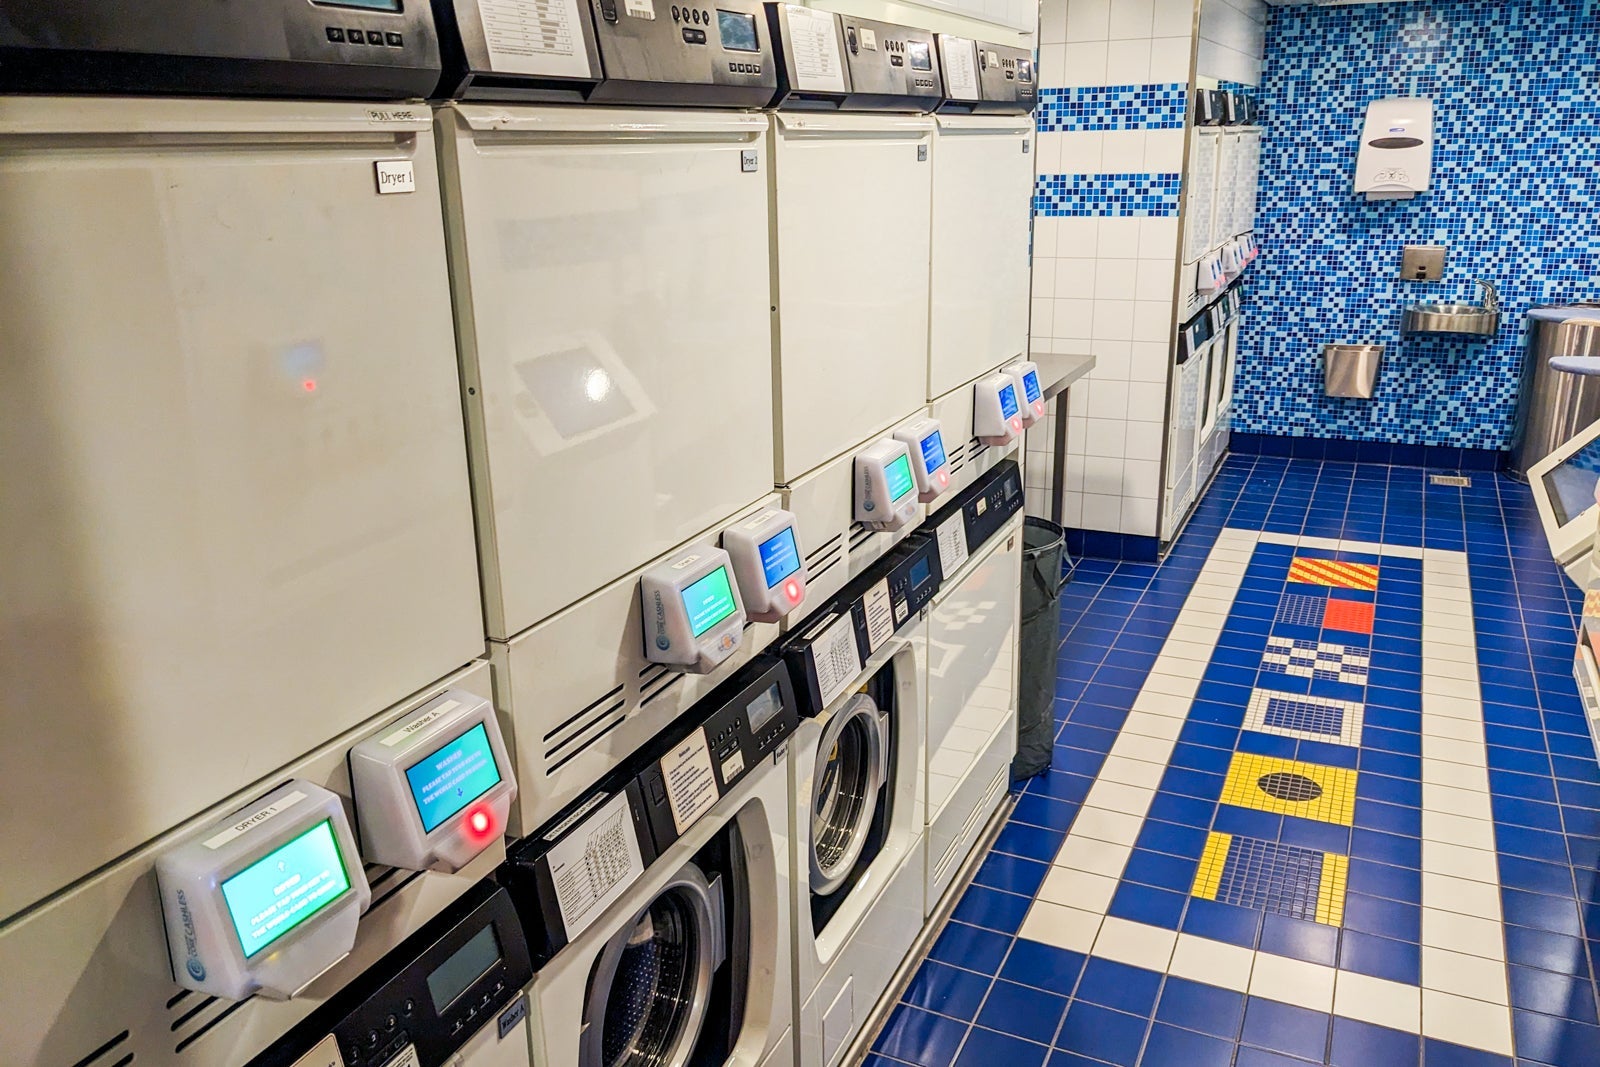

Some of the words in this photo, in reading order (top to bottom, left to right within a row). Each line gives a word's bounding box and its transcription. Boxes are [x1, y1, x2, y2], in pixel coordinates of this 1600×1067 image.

[371, 111, 391, 120] PULL
[392, 111, 414, 120] HERE
[380, 171, 406, 186] Dryer
[407, 171, 413, 184] 1
[403, 716, 432, 733] Washer
[422, 776, 443, 793] PLEASE
[235, 811, 271, 832] DRYER
[176, 888, 192, 936] CASHLESS
